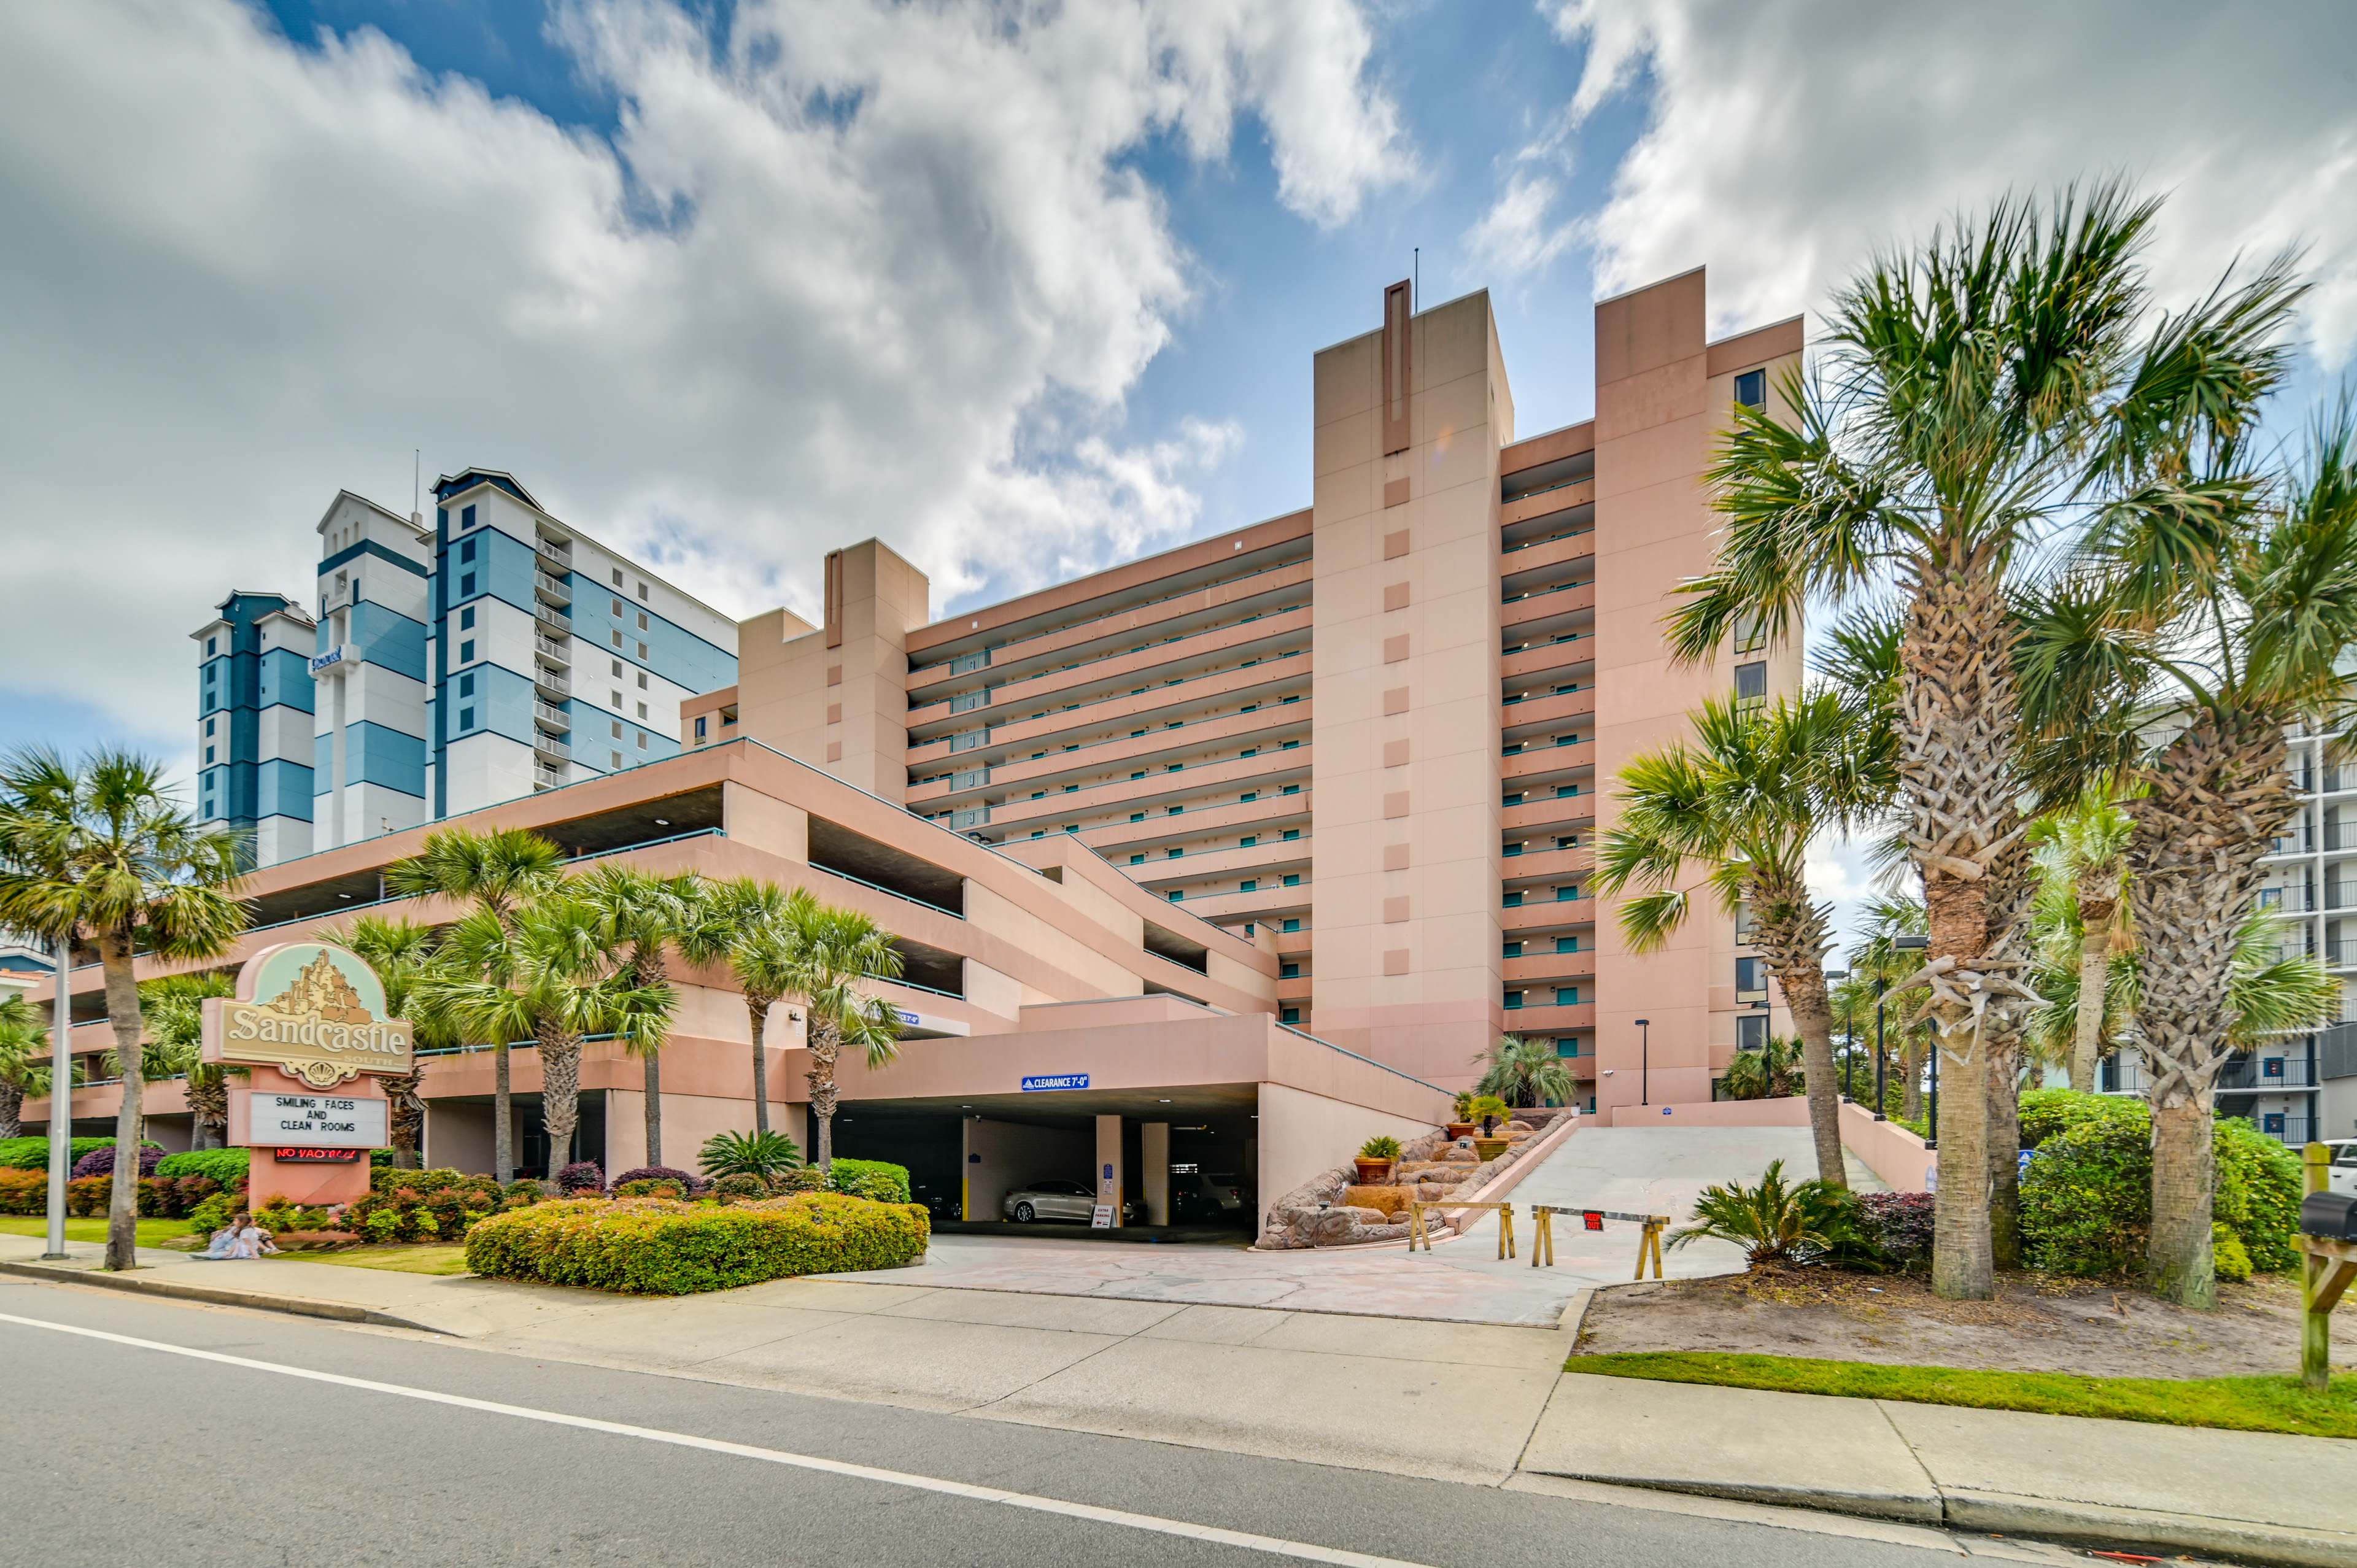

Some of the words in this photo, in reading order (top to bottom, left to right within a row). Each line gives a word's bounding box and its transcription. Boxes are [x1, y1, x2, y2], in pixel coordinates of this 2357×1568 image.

[344, 1055, 393, 1065] SOUTH
[1034, 1078, 1070, 1088] CLEARANCE
[1072, 1076, 1087, 1086] 7'-0"
[276, 1097, 316, 1108] SMILING
[325, 1100, 354, 1110] FACES
[307, 1110, 327, 1120] AND
[281, 1120, 312, 1130] CLEAN
[321, 1122, 355, 1132] ROOMS
[277, 1149, 296, 1157] NO
[1584, 1212, 1601, 1221] KEEP
